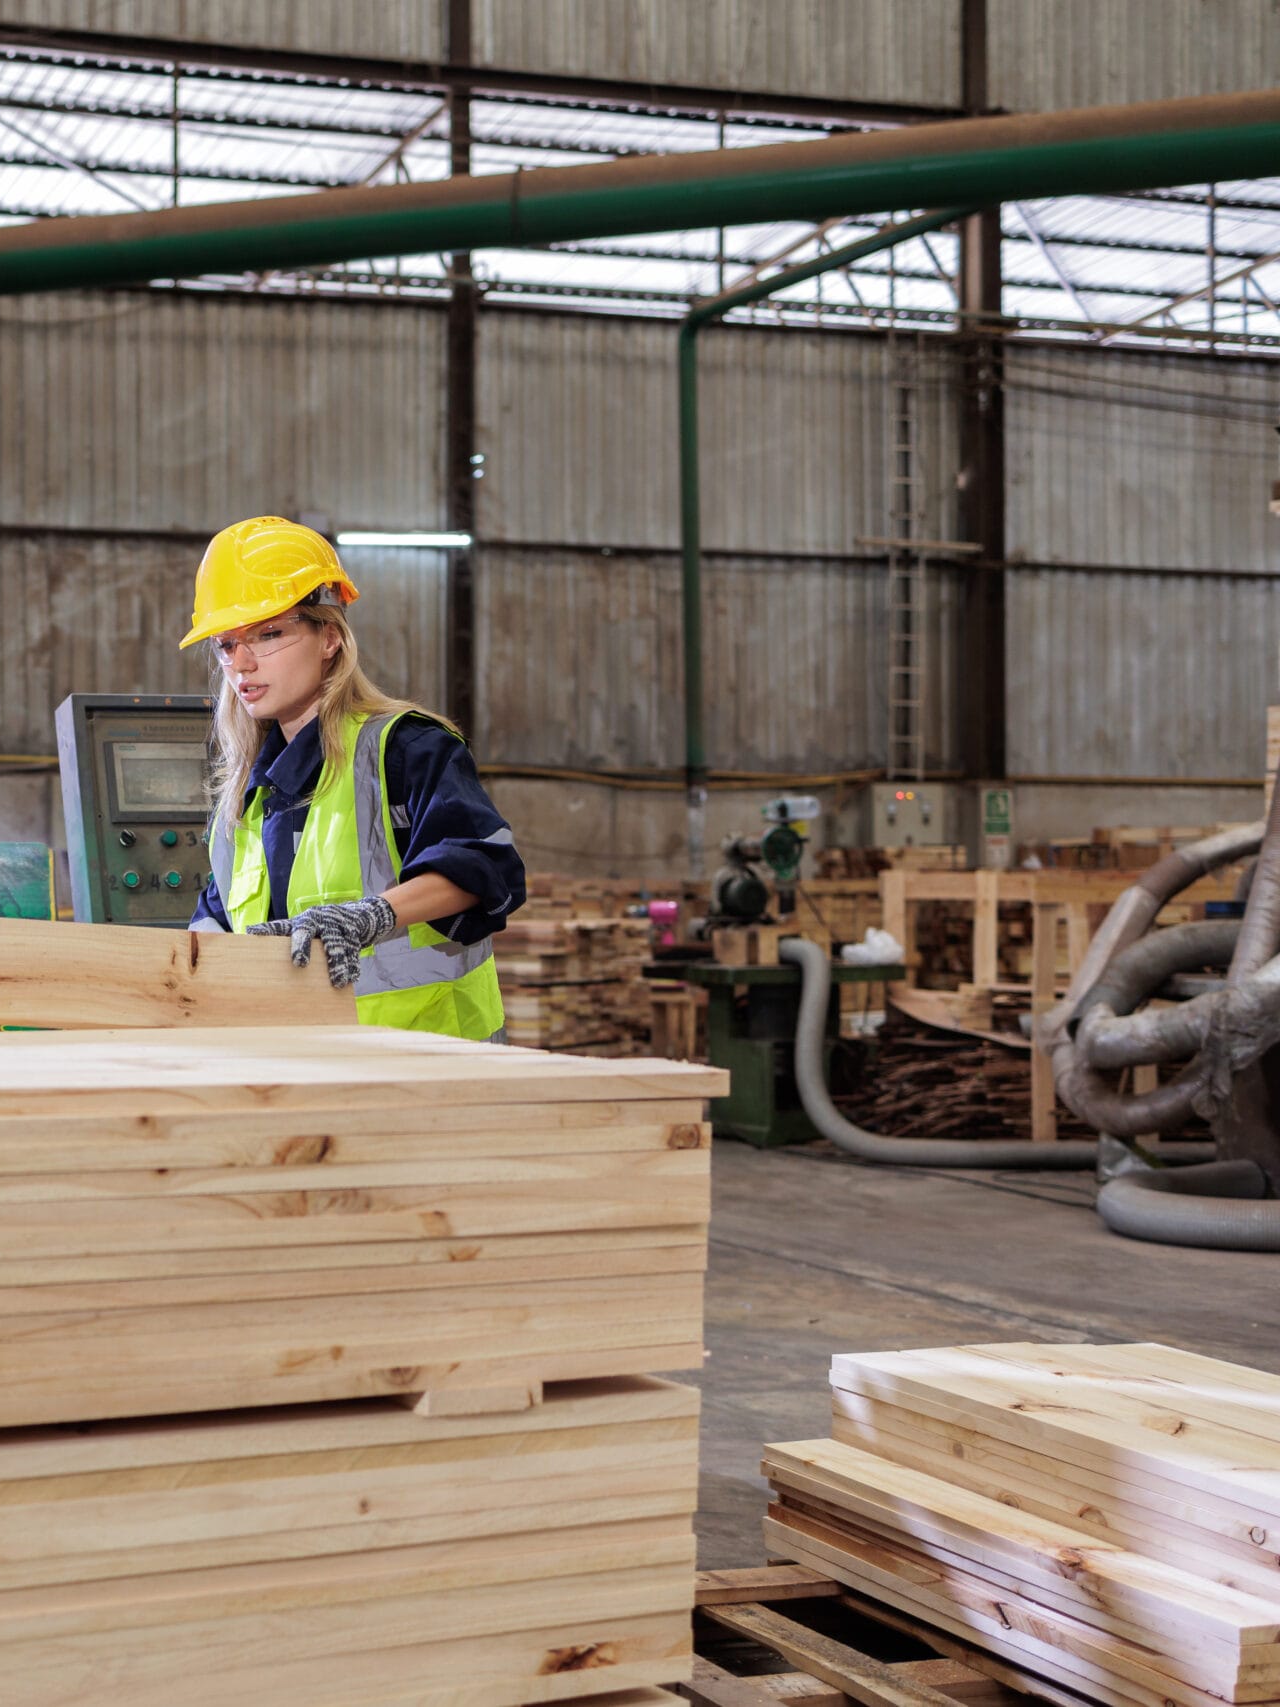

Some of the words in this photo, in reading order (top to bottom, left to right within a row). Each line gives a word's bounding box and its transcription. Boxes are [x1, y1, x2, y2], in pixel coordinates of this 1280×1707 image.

[185, 830, 197, 847] 3
[109, 874, 119, 890] 2
[150, 873, 161, 892] 4
